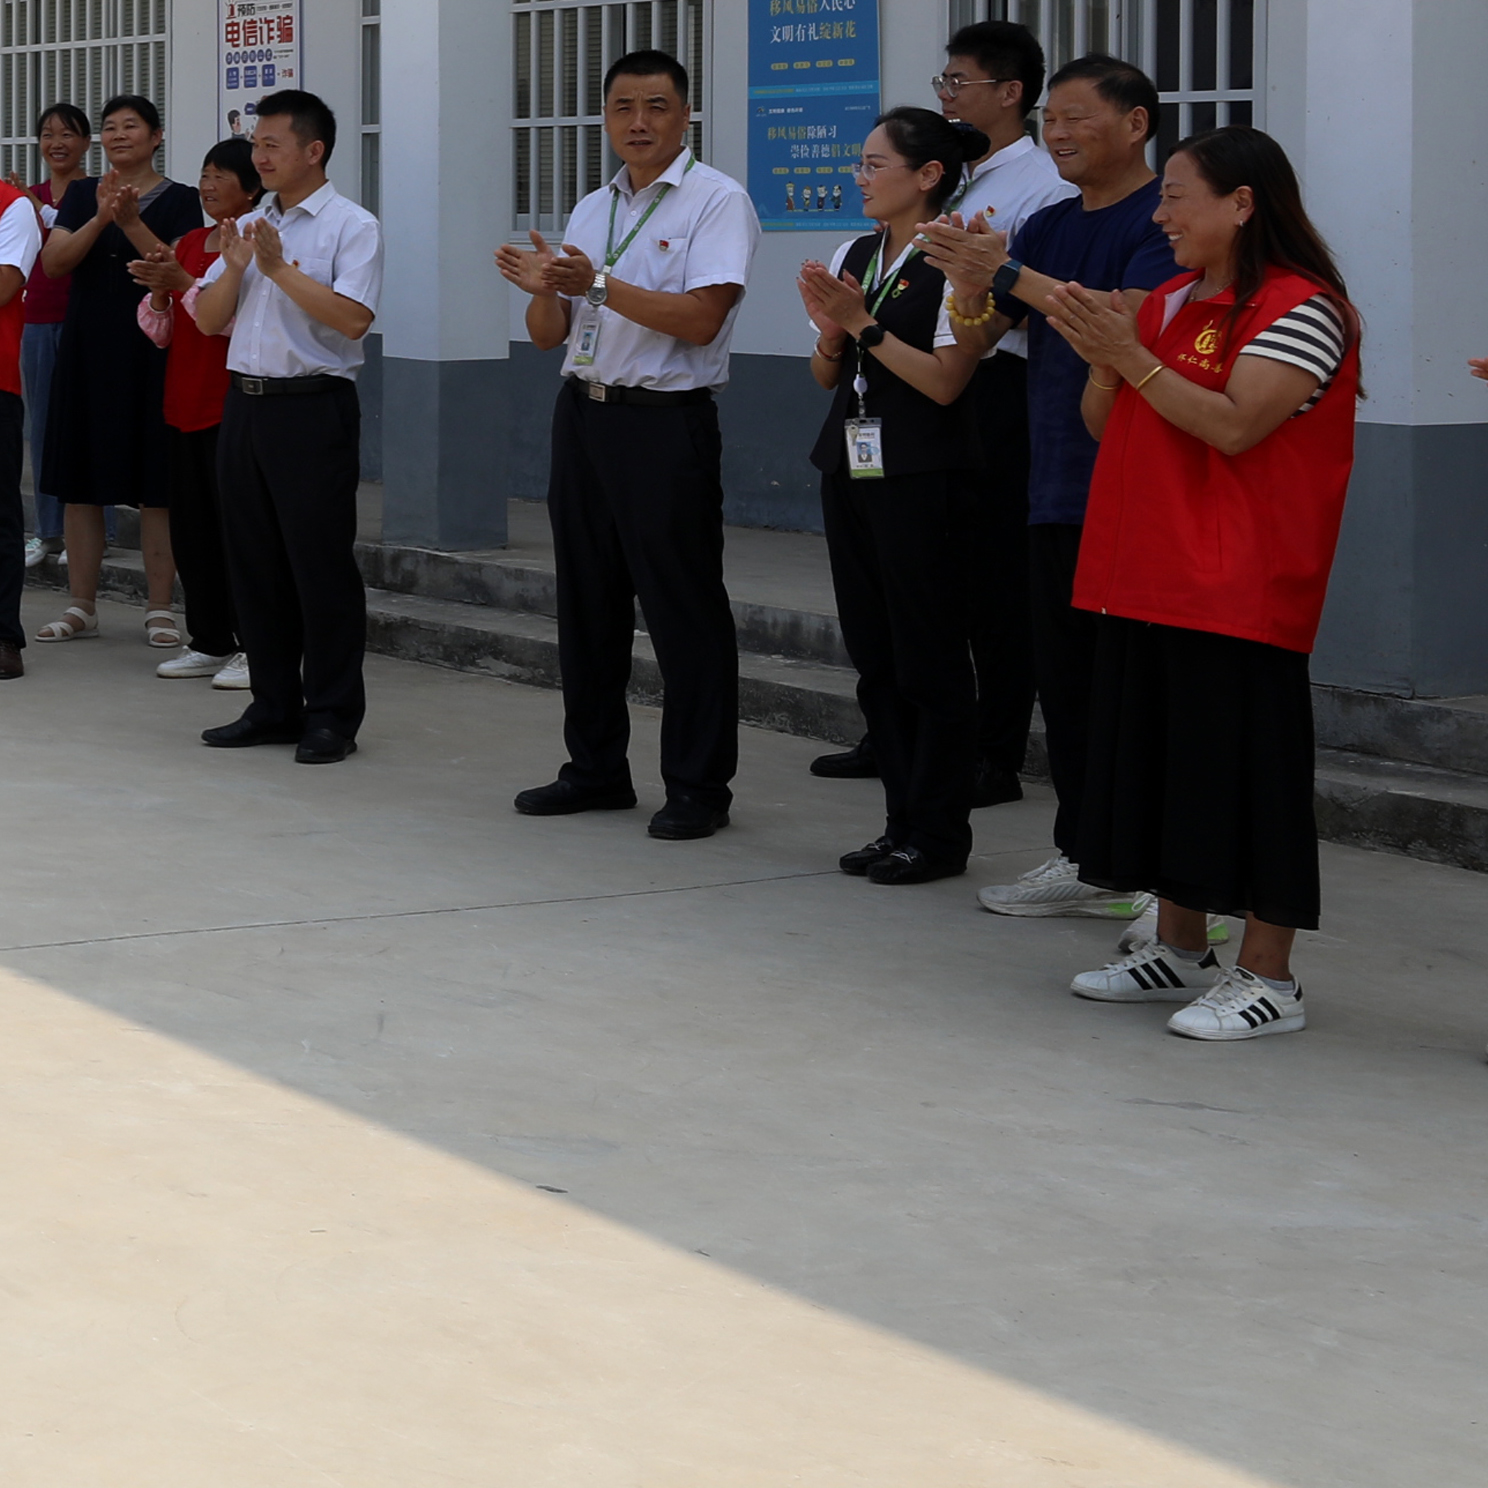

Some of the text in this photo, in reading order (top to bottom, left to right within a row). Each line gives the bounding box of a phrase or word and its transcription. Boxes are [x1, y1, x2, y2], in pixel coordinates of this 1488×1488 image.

[237, 3, 255, 17] 预防
[225, 15, 293, 48] 电信诈骗
[770, 20, 856, 43] 文明有礼绽新花
